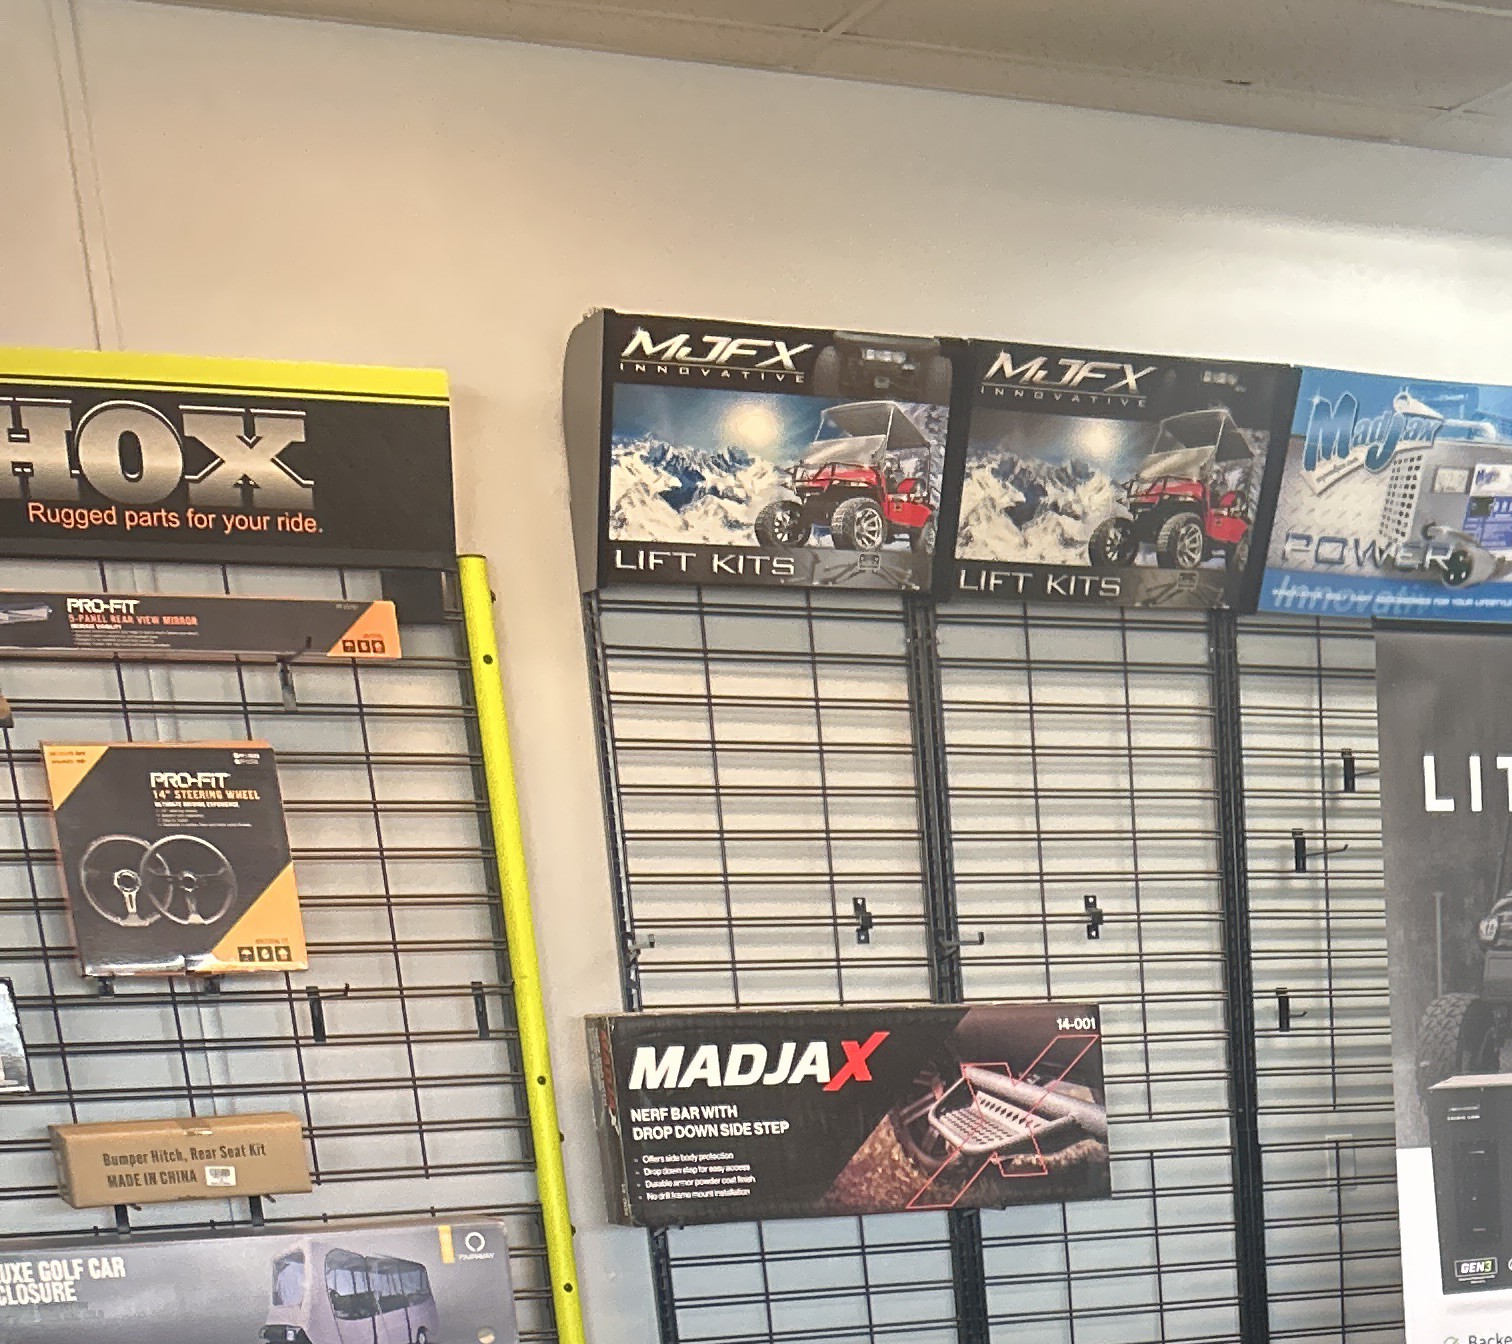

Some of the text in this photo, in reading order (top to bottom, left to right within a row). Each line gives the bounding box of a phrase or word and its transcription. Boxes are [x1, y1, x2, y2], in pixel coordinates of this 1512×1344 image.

[619, 361, 805, 383] INNOVATIVE
[981, 385, 1147, 408] INNOVATIVE
[27, 502, 324, 534] Rugged parts for your ride.
[1284, 531, 1452, 571] POWER
[614, 549, 796, 576] LIFT KITS
[958, 569, 1122, 597] LIFT KITS
[66, 598, 140, 614] PRO-FIT
[149, 772, 231, 789] PRO-FIT
[174, 789, 223, 800] STEERING
[225, 789, 261, 800] WHEEL
[1056, 1017, 1096, 1031] 14-001
[628, 1031, 890, 1092] MADJAX
[630, 1104, 739, 1123] NERF BAR WITH
[632, 1120, 790, 1141] DROP DOWN SIDE STEP
[103, 1143, 267, 1167] Bumper Hitch, Rear Seat Kit
[107, 1173, 140, 1188] MADE
[144, 1172, 158, 1186] IN
[160, 1169, 198, 1185] CHINA
[37, 1259, 84, 1281] GOLF
[88, 1256, 126, 1279] CAR
[1460, 1260, 1493, 1274] GEN3
